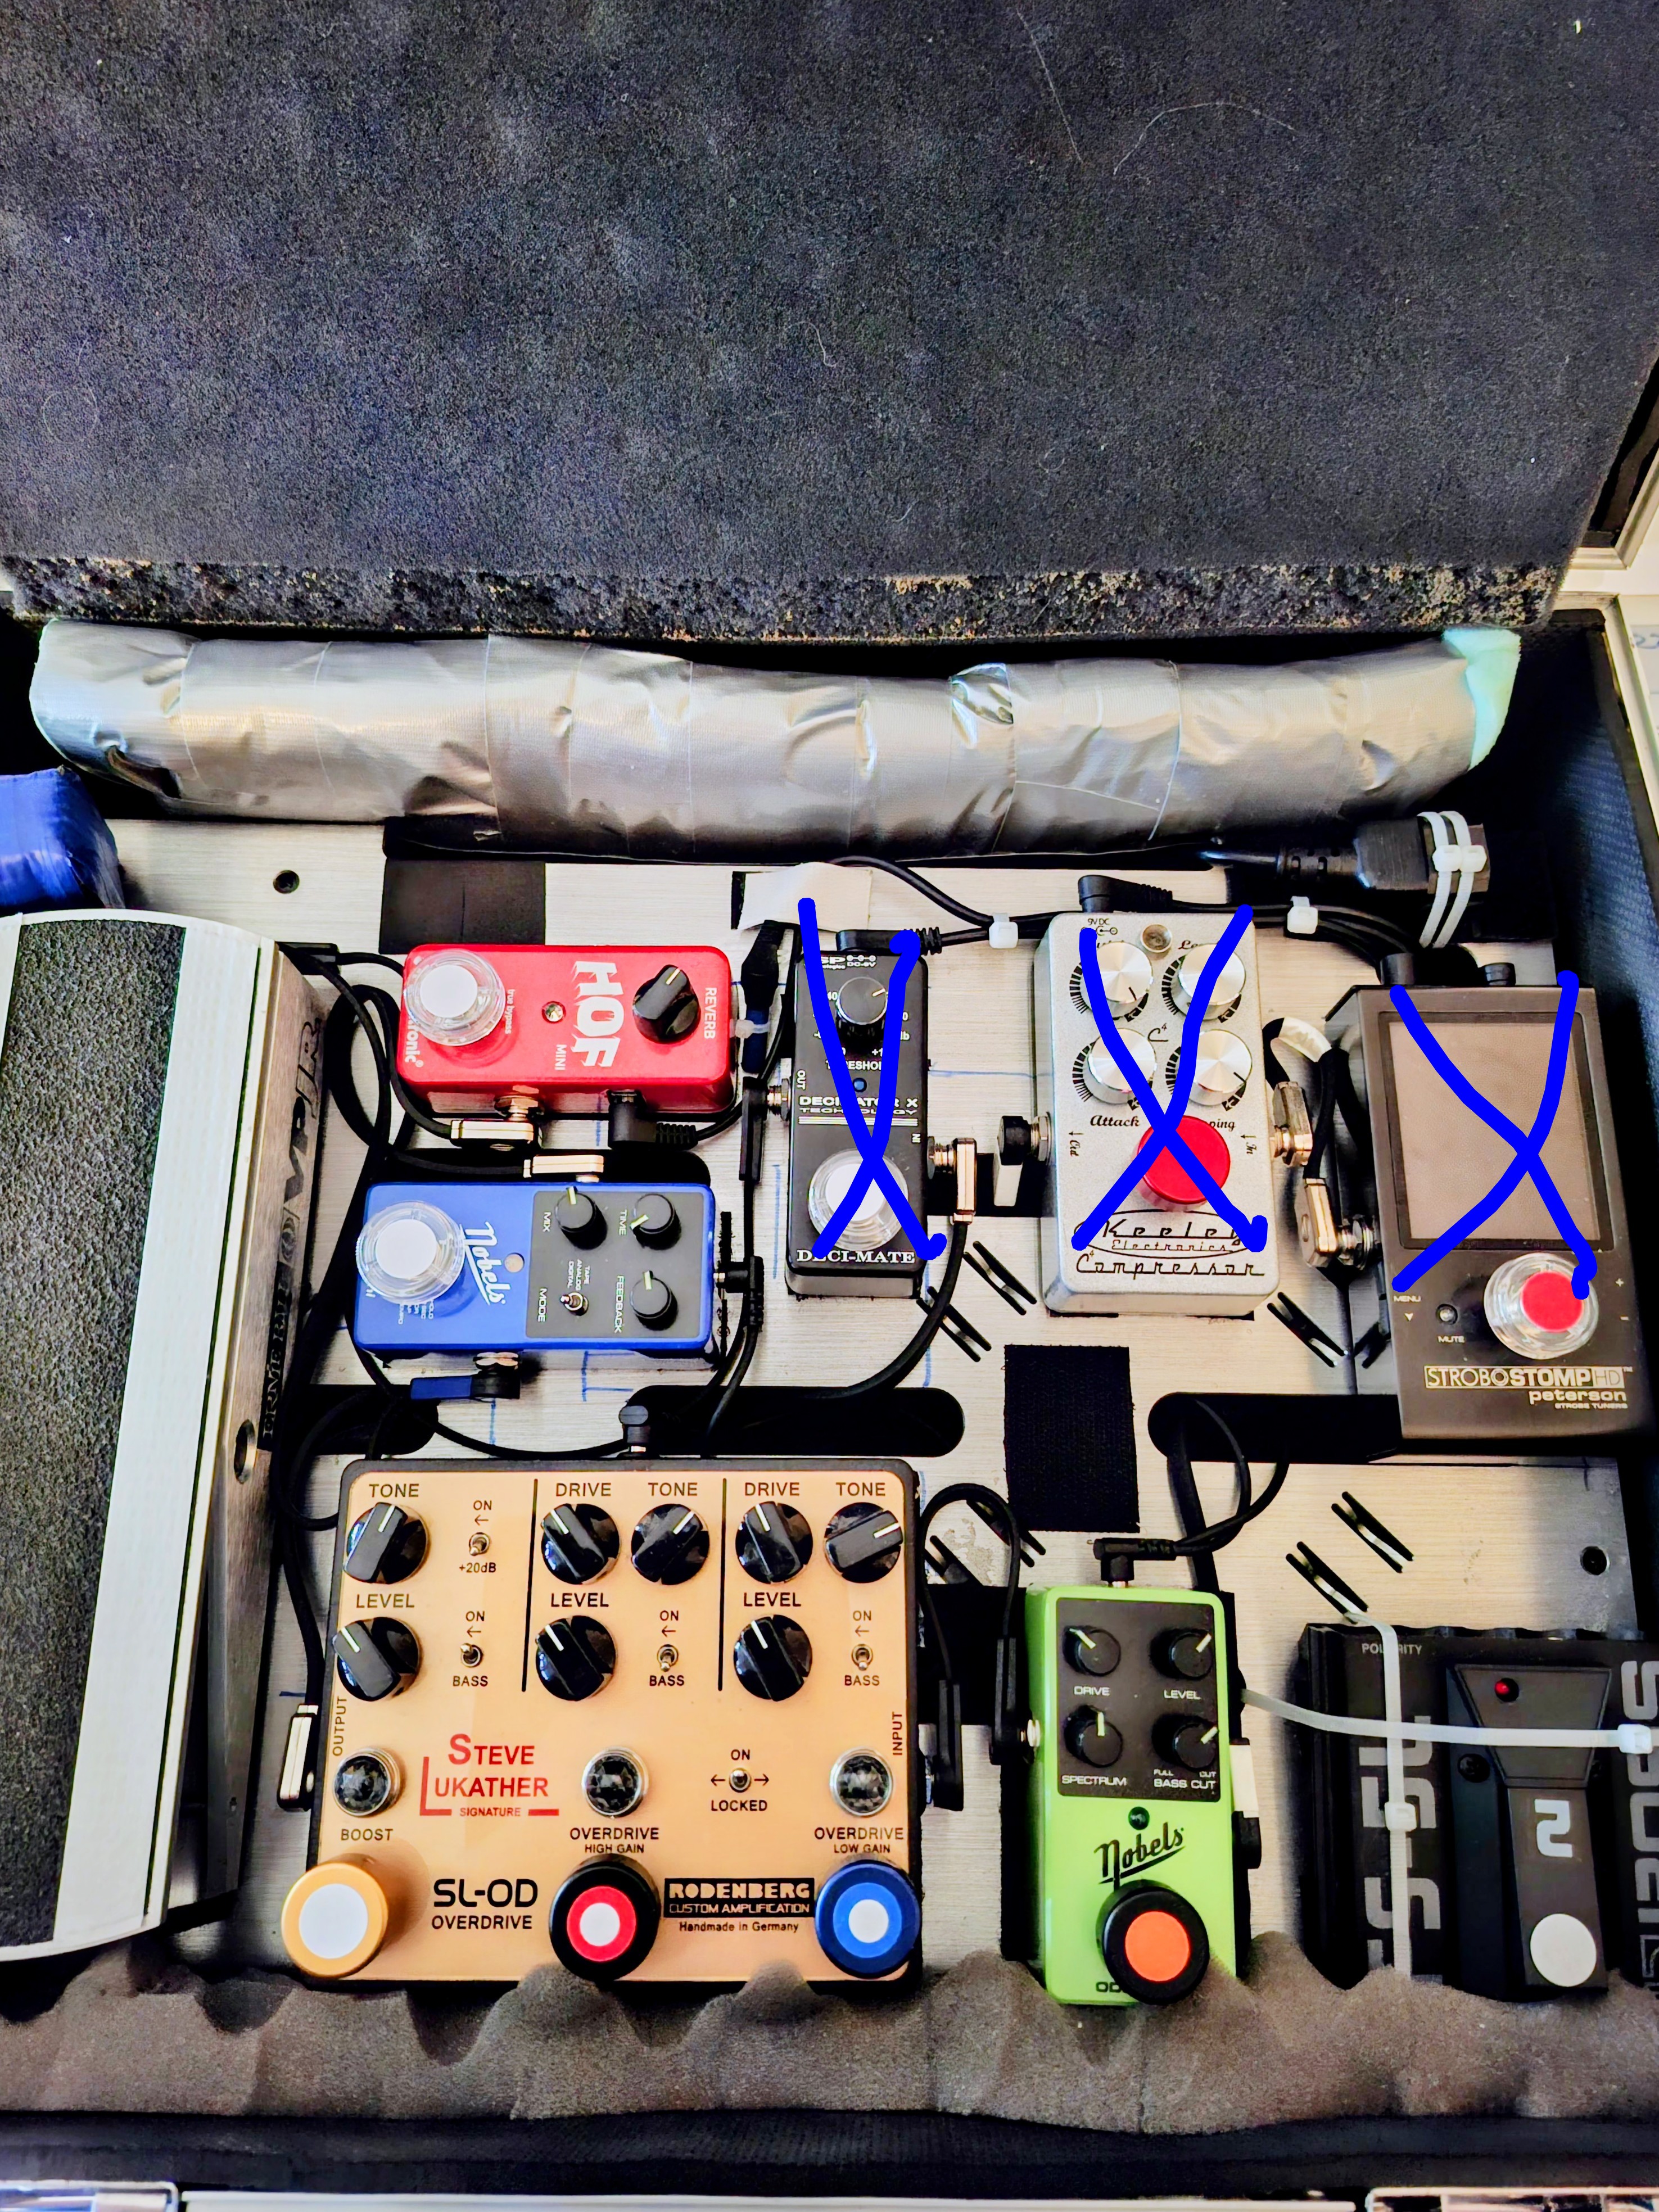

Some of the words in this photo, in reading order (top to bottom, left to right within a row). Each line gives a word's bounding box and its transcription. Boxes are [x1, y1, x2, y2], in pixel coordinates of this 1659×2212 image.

[507, 989, 516, 1004] true
[504, 1005, 515, 1034] bypass
[571, 961, 625, 1067] HOF
[704, 987, 718, 1039] REVERB
[404, 1017, 421, 1063] tronic
[555, 1044, 567, 1070] MINI
[825, 1060, 882, 1070] TRESHO
[797, 1070, 806, 1090] OUT
[799, 1096, 899, 1107] DECIATR
[906, 1098, 918, 1108] X
[1090, 1115, 1140, 1127] Attack
[1209, 1118, 1236, 1132] ping
[912, 1133, 921, 1143] IN
[1247, 1142, 1257, 1155] In
[543, 1211, 552, 1232] MIX
[618, 1210, 627, 1236] TIME
[1102, 1219, 1241, 1246] Keeley
[1111, 1239, 1235, 1253] Electronics
[460, 1221, 511, 1305] Nobels
[796, 1250, 915, 1264] DCI-MATE
[537, 1287, 548, 1323] MODE
[614, 1275, 625, 1333] FEEDBACK
[1529, 1389, 1627, 1405] peterson
[369, 1483, 419, 1498] TONE
[555, 1482, 612, 1497] DRIVE
[648, 1482, 698, 1497] TONE
[744, 1482, 800, 1496] DRIVE
[835, 1482, 886, 1496] TONE
[473, 1500, 492, 1511] ON
[459, 1562, 497, 1573] +20dB
[356, 1594, 415, 1609] LEVEL
[550, 1593, 609, 1608] LEVEL
[743, 1592, 801, 1607] LEVEL
[465, 1611, 485, 1622] ON
[659, 1610, 679, 1621] ON
[852, 1610, 872, 1621] ON
[1362, 1643, 1423, 1655] POLRITY
[453, 1675, 489, 1687] BASS
[649, 1675, 685, 1686] BASS
[844, 1675, 880, 1686] BASS
[1074, 1686, 1110, 1696] DRIVE
[1164, 1689, 1201, 1700] LEVEL
[332, 1696, 347, 1756] OUTPUT
[892, 1711, 902, 1756] INPUT
[447, 1733, 535, 1765] STEVE
[730, 1749, 751, 1761] ON
[1061, 1775, 1127, 1786] SPECTRUM
[1154, 1778, 1187, 1789] BASS
[1191, 1779, 1216, 1789] CUT
[459, 1807, 521, 1817] SIGNATURE
[710, 1799, 767, 1812] LOCKED
[341, 1828, 394, 1841] BOOST
[569, 1827, 659, 1840] OVERDRIVE
[814, 1827, 904, 1840] OVERDRIVE
[1534, 1798, 1573, 1858] 2
[585, 1844, 614, 1854] HIGH
[617, 1844, 644, 1854] GAIN
[834, 1844, 860, 1854] LOW
[862, 1844, 890, 1854] GAIN
[1094, 1821, 1186, 1891] Nobels
[433, 1878, 538, 1908] SL-OD
[669, 1883, 810, 1898] RODENBERG
[670, 1903, 718, 1914] CUSTOM
[722, 1903, 810, 1914] AMPLIFICATION
[432, 1915, 533, 1930] OVERDRIVE
[679, 1921, 735, 1932] Handmade
[738, 1921, 748, 1931] in
[752, 1921, 799, 1933] Germany
